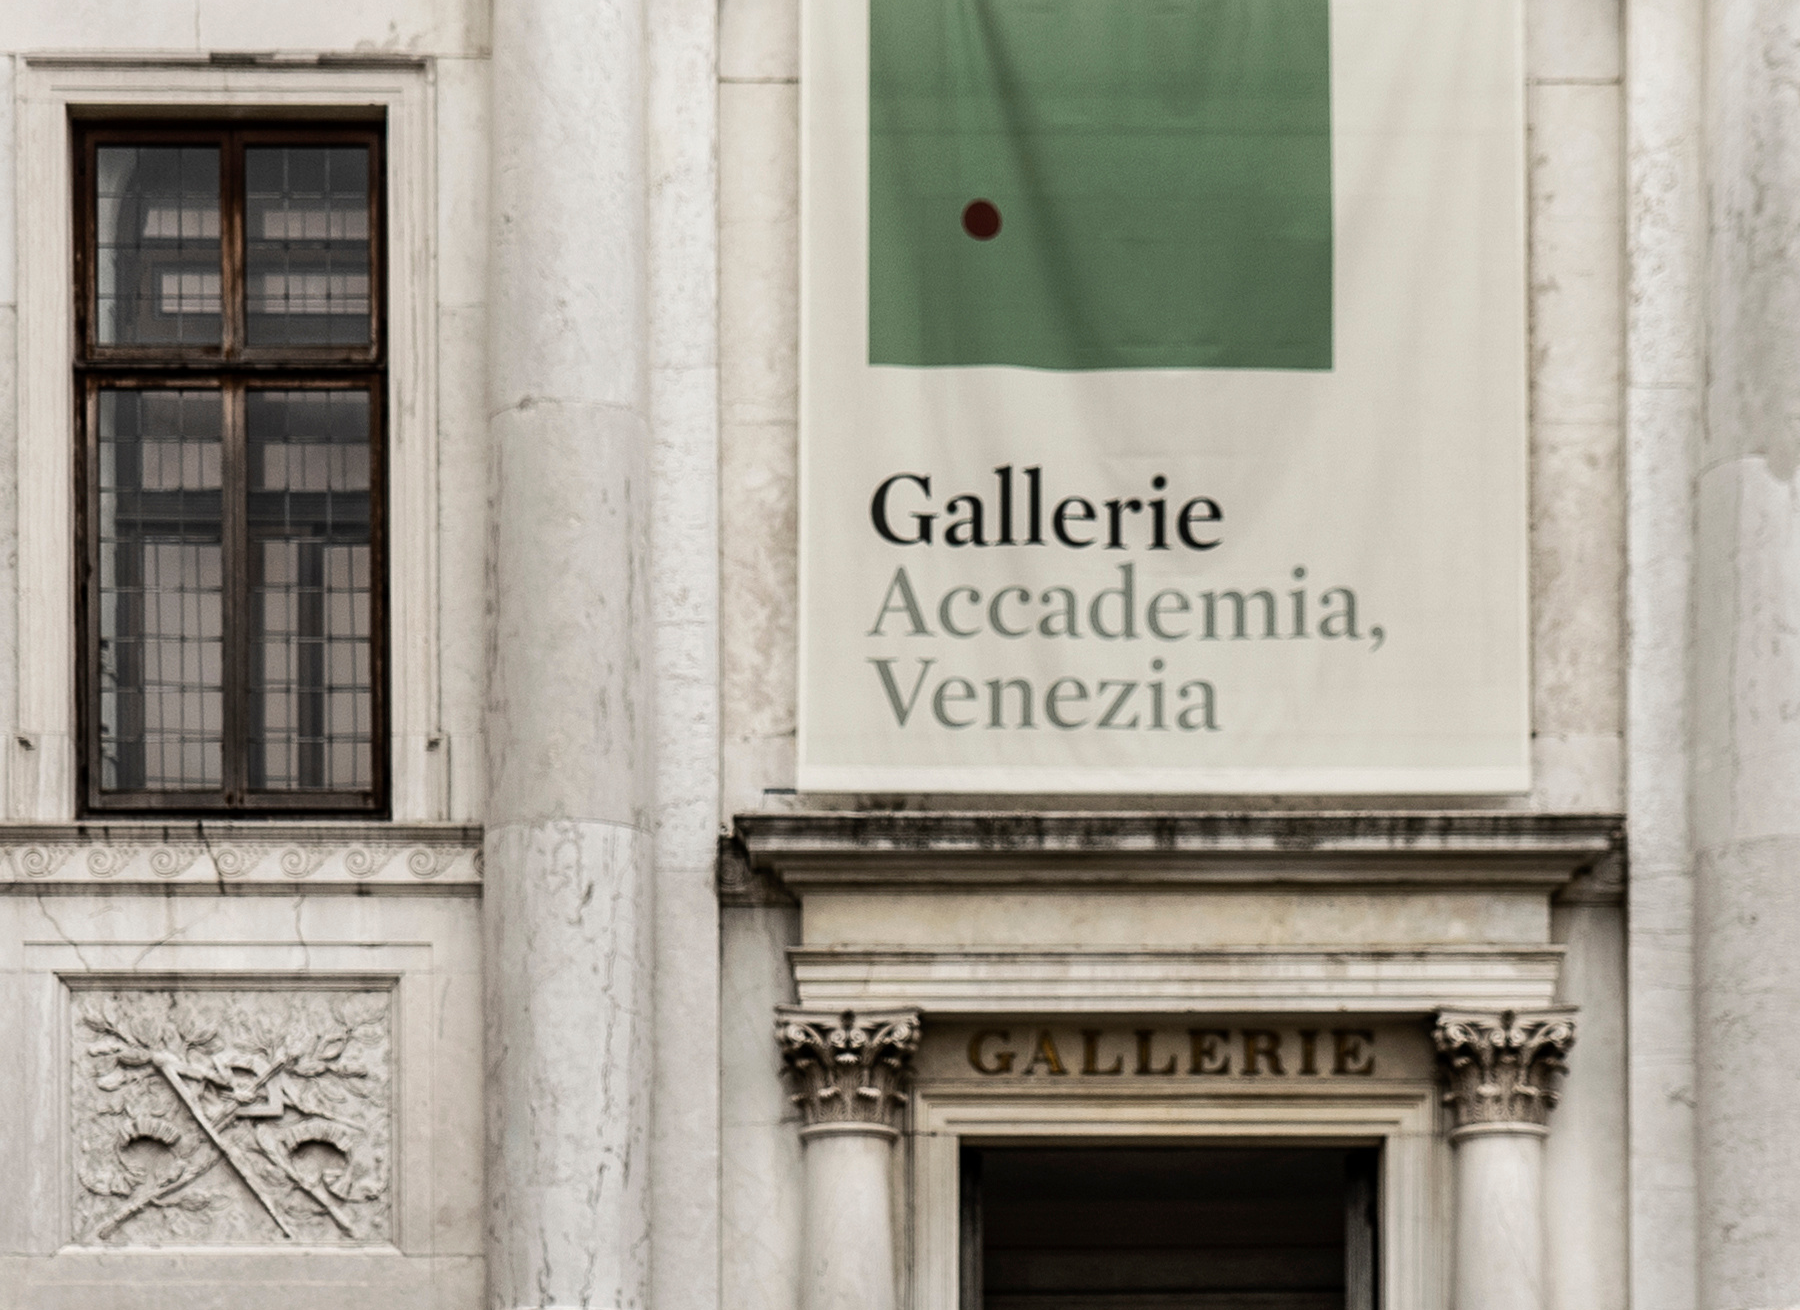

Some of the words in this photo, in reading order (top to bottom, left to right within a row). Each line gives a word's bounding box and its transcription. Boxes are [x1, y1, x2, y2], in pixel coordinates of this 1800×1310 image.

[869, 464, 1225, 552] Gallerie
[866, 562, 1387, 653] Accademia,
[865, 657, 1224, 733] Venezia
[966, 1027, 1377, 1077] GALLERIE
